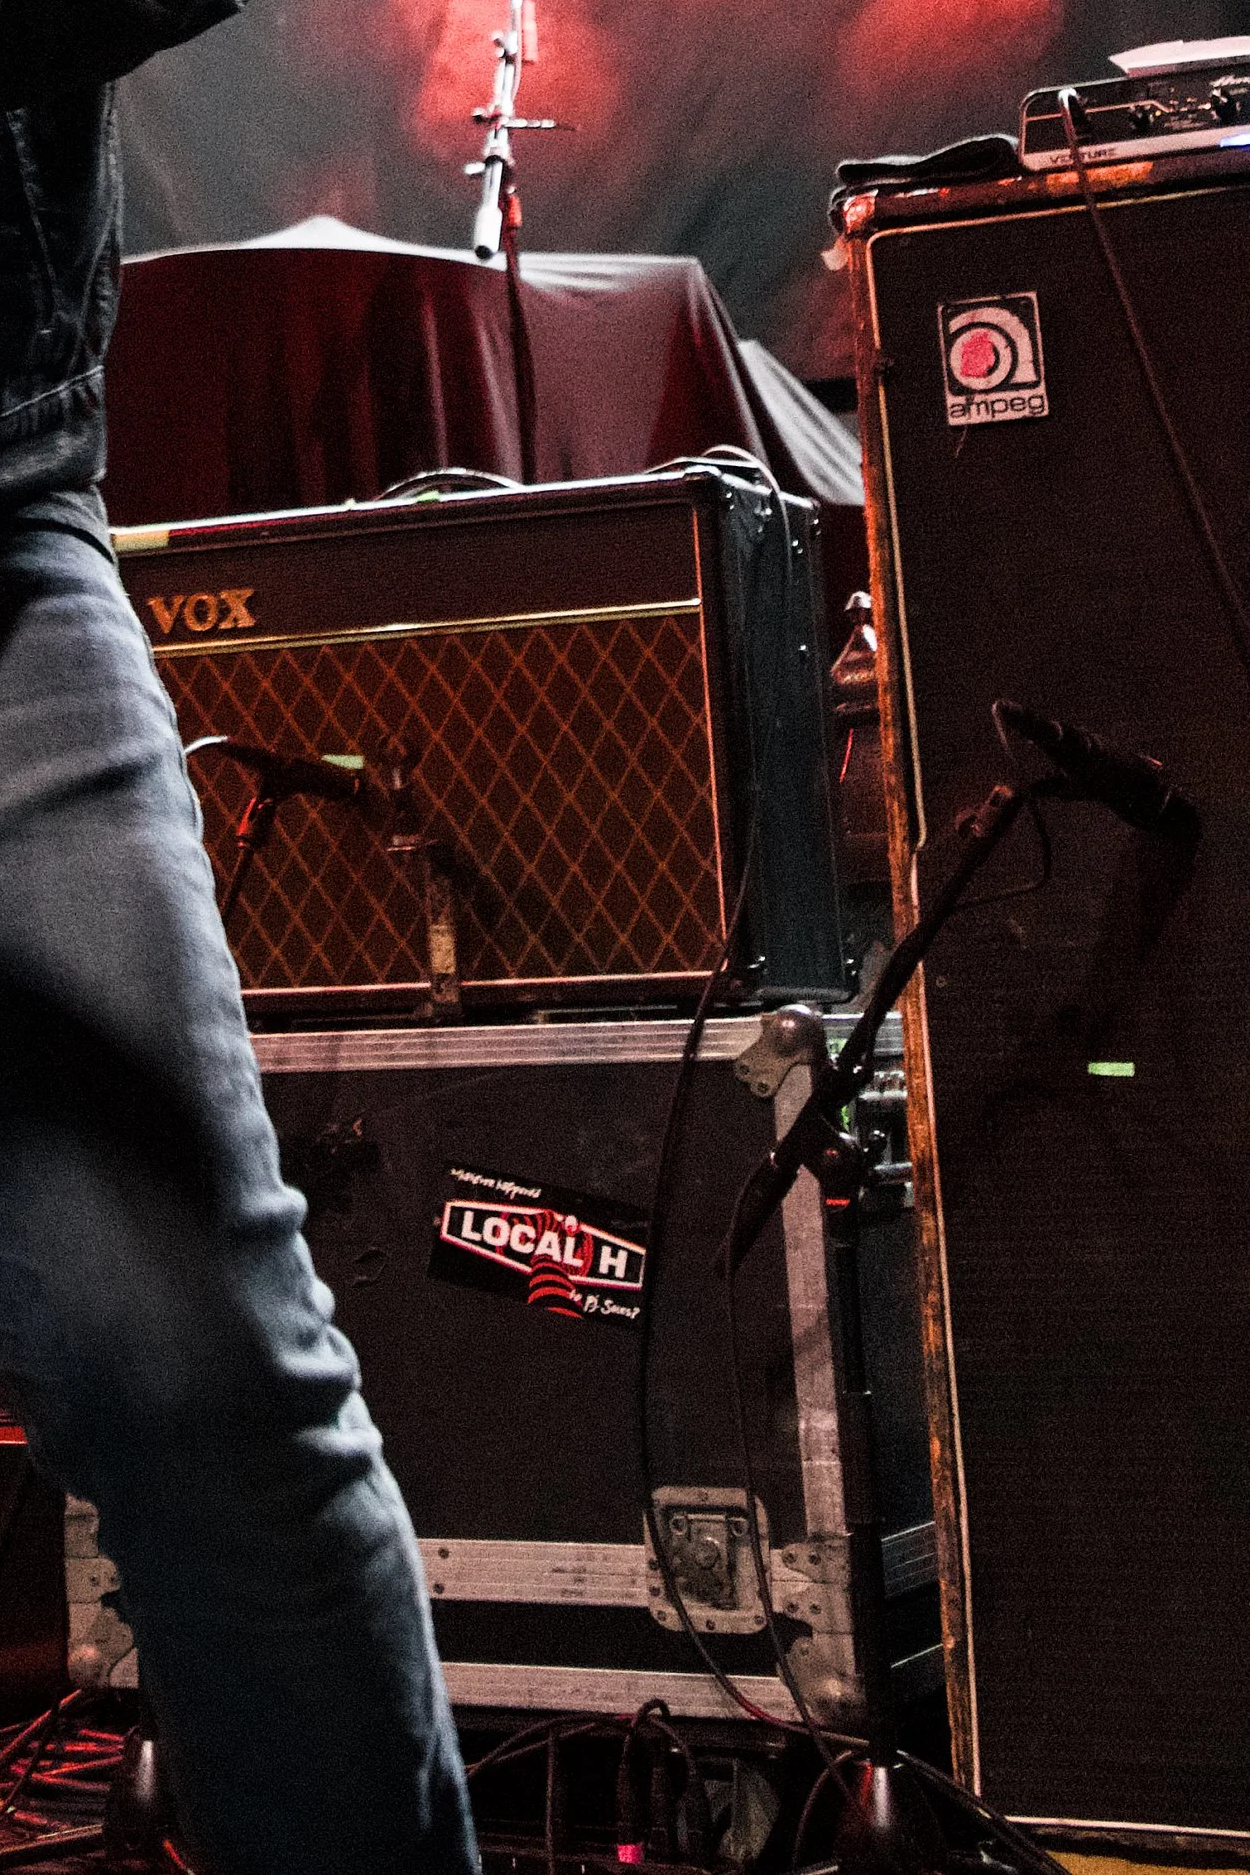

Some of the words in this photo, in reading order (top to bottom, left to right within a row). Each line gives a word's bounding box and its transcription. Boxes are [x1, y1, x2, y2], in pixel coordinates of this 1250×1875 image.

[1050, 147, 1115, 165] VETURE
[950, 393, 1045, 419] ampeg
[148, 588, 256, 635] VOX
[461, 1210, 585, 1268] LOCAL
[598, 1244, 629, 1279] H
